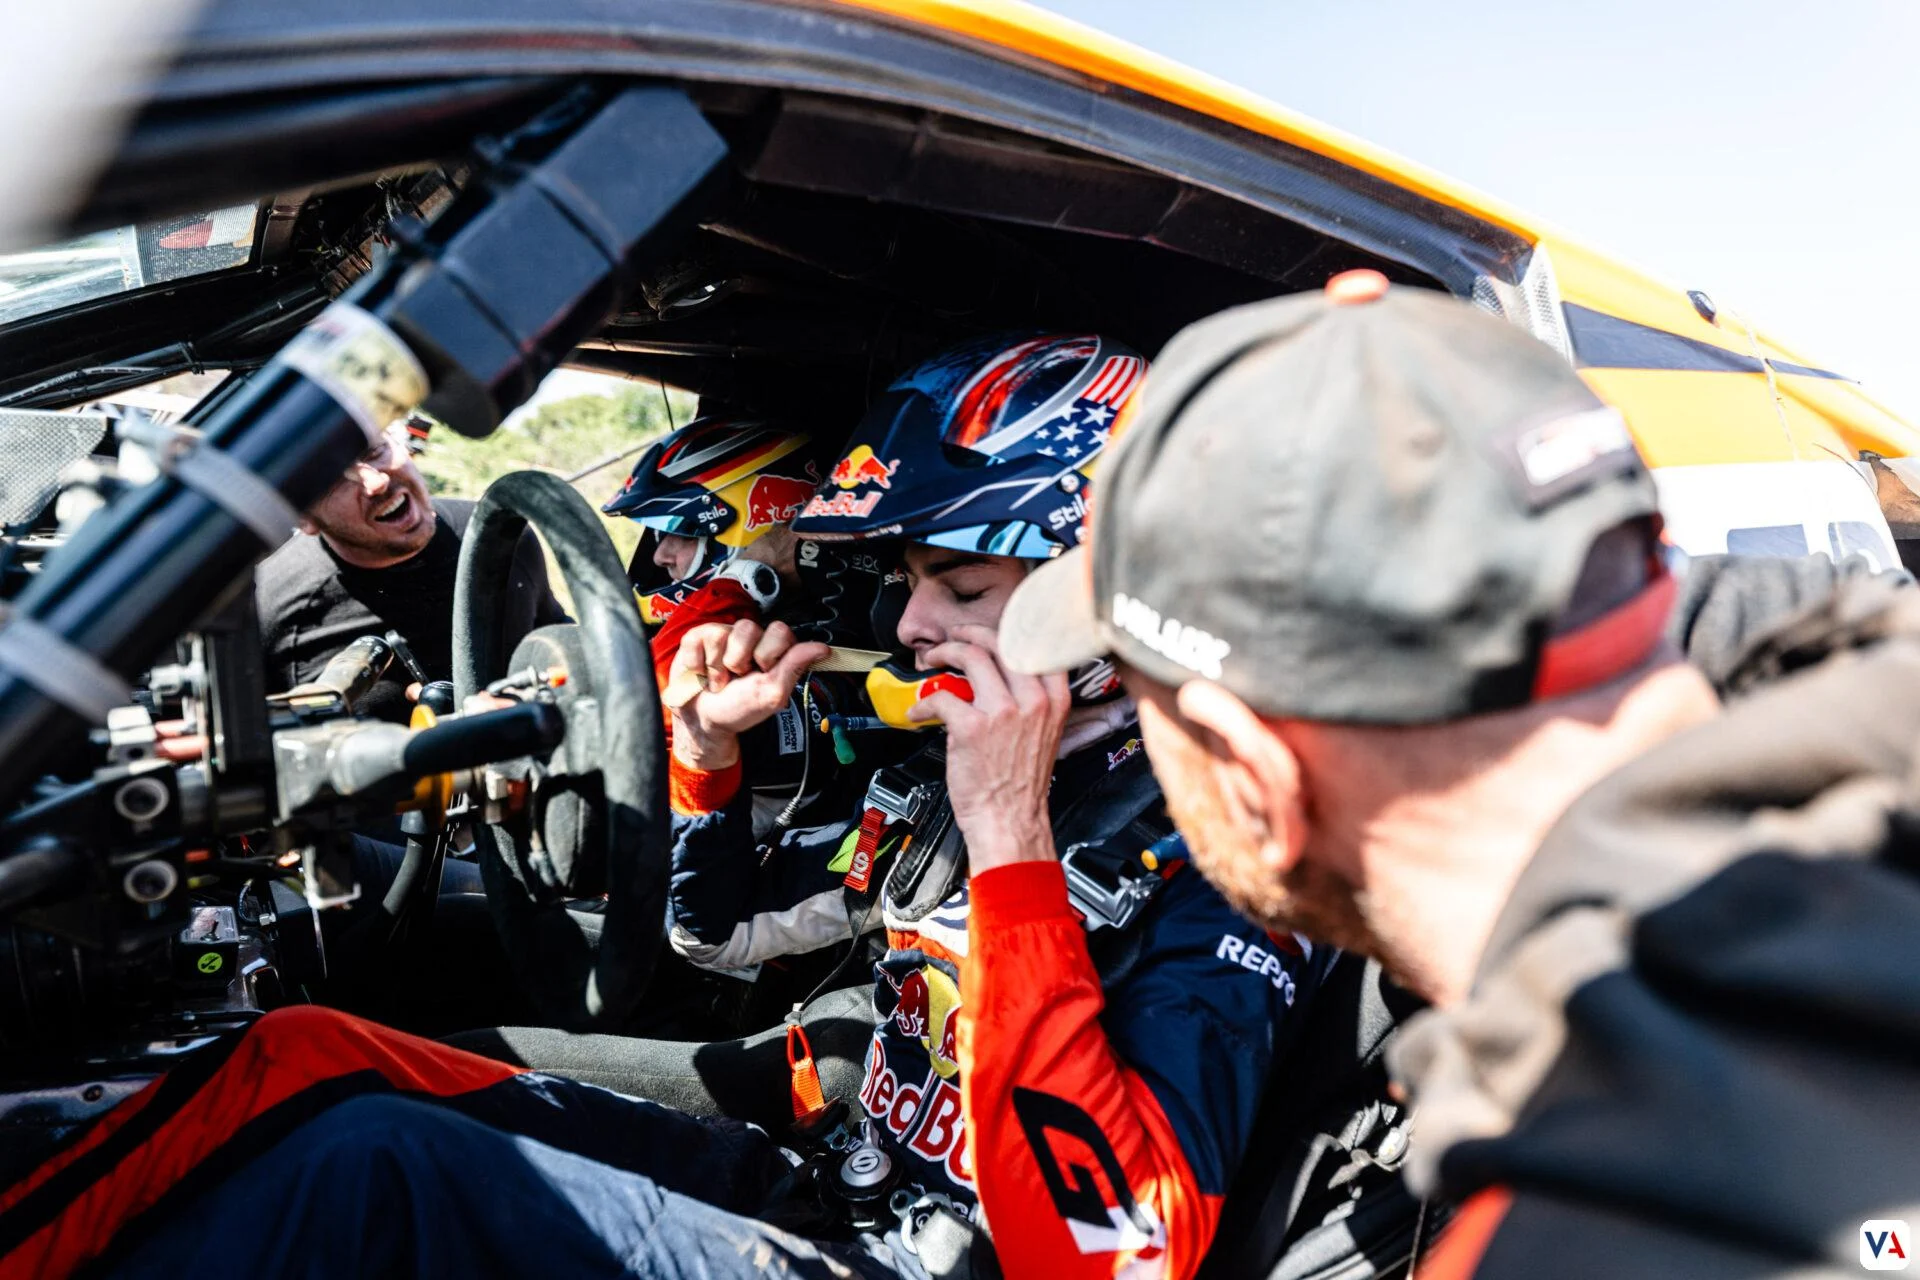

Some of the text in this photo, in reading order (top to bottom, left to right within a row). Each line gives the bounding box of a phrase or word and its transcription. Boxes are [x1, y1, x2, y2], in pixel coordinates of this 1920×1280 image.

[697, 505, 728, 523] Stilo
[1215, 933, 1297, 1008] REPSO
[907, 1076, 976, 1190] Bu
